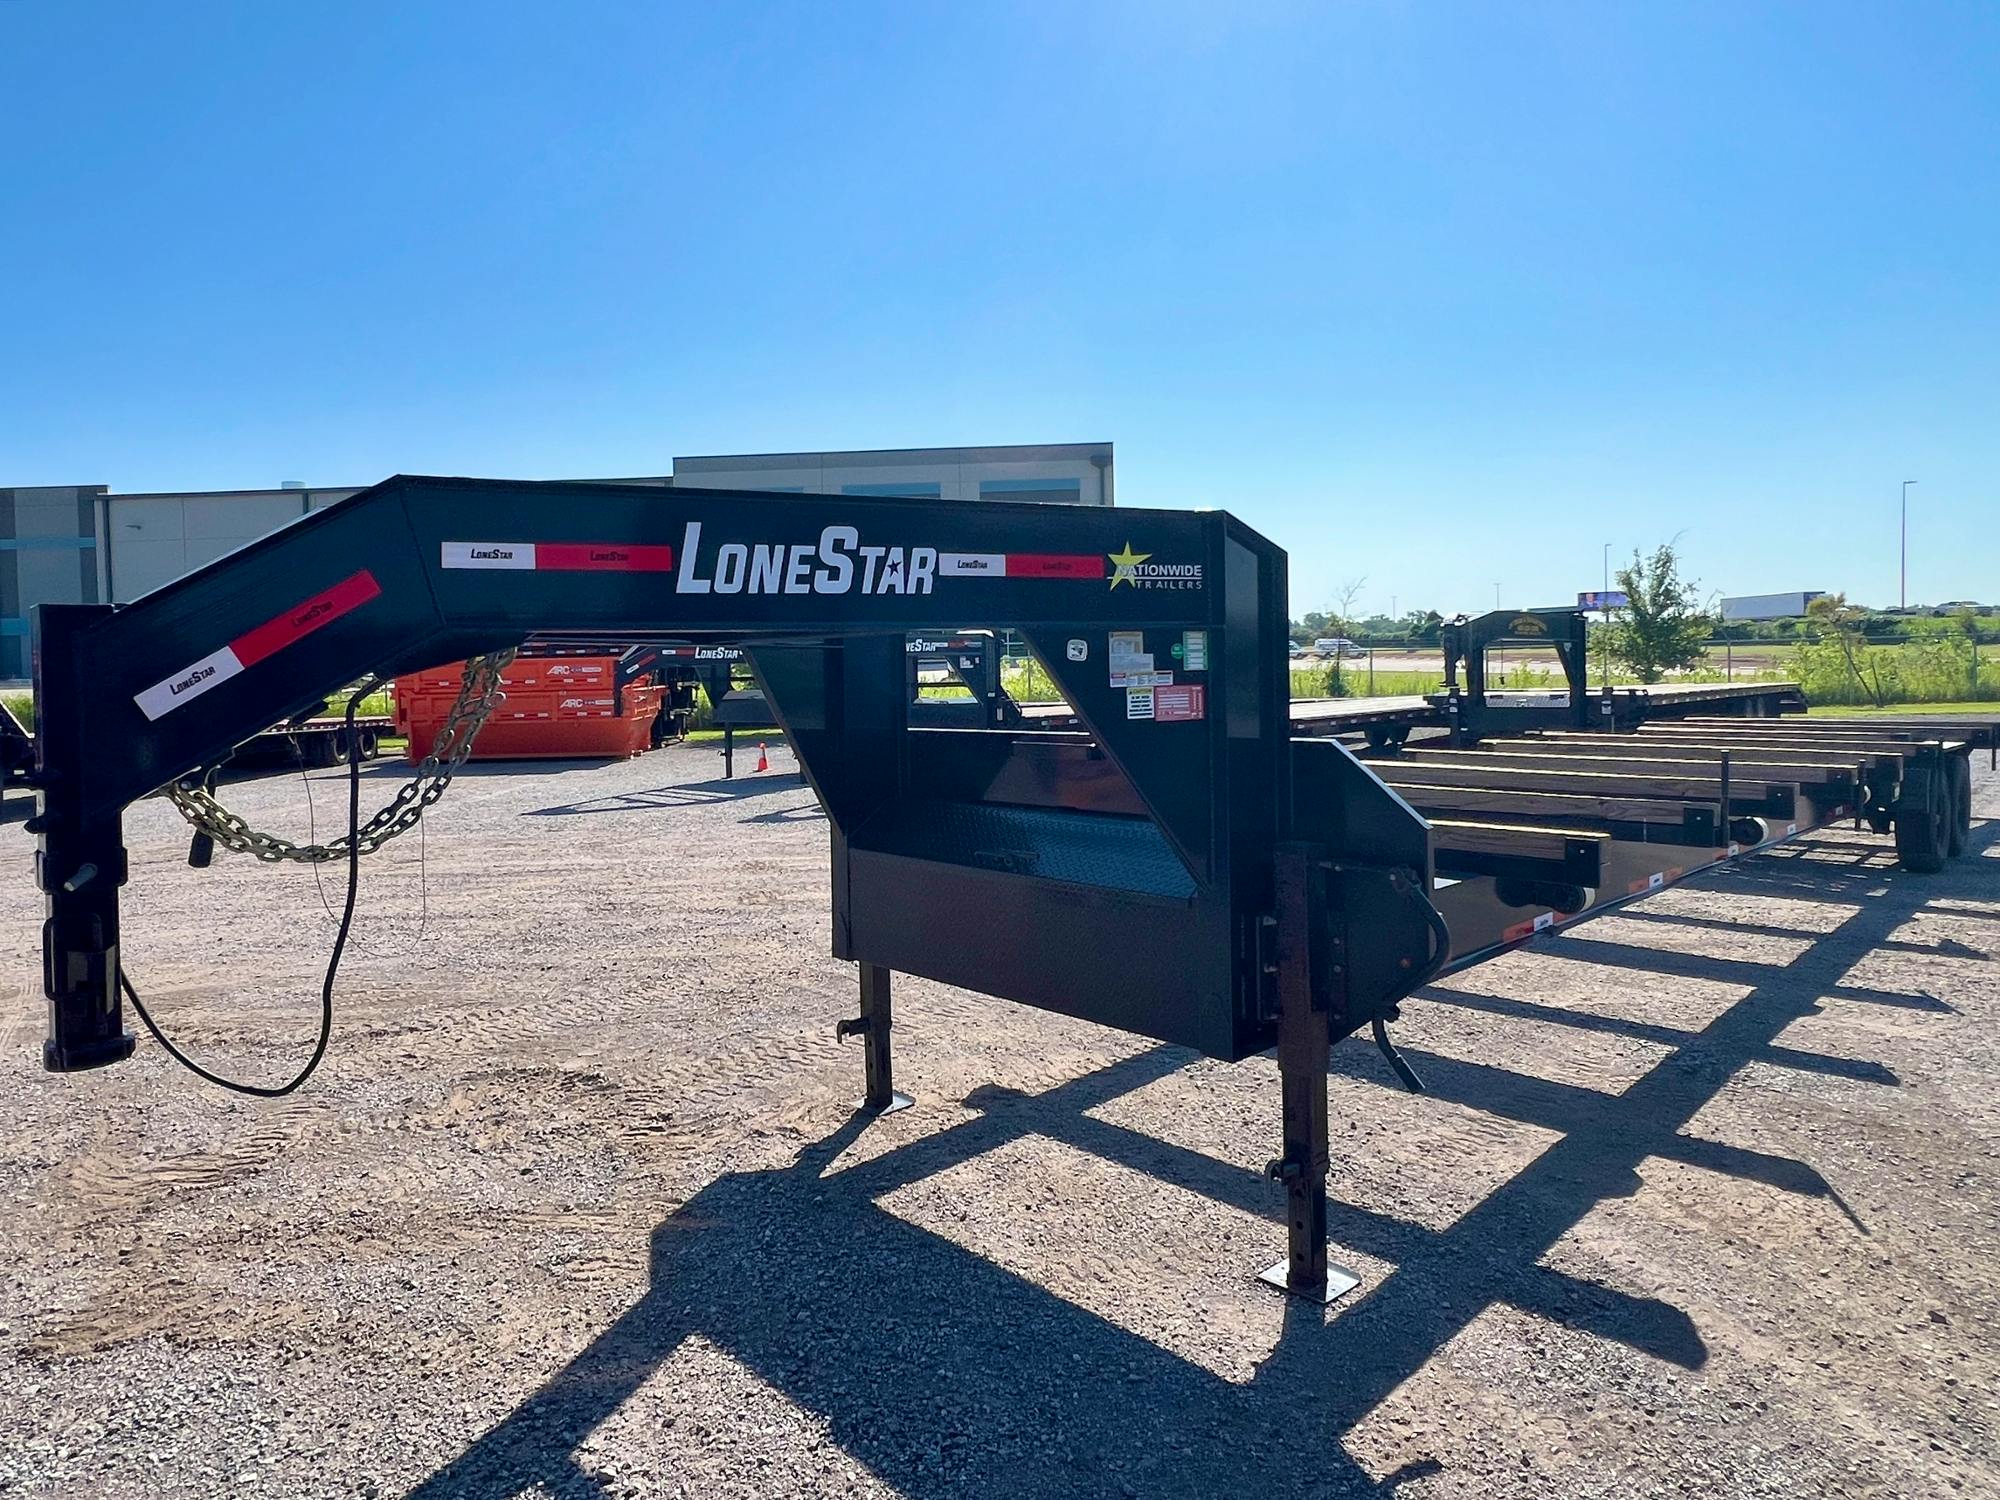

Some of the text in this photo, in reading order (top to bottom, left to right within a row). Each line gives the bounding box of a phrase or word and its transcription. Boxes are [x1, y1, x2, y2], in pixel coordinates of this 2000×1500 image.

[1118, 564, 1202, 576] NATIONWIDE
[1136, 580, 1203, 589] TRAILERS
[547, 665, 570, 675] ARC
[560, 698, 583, 708] ARC
